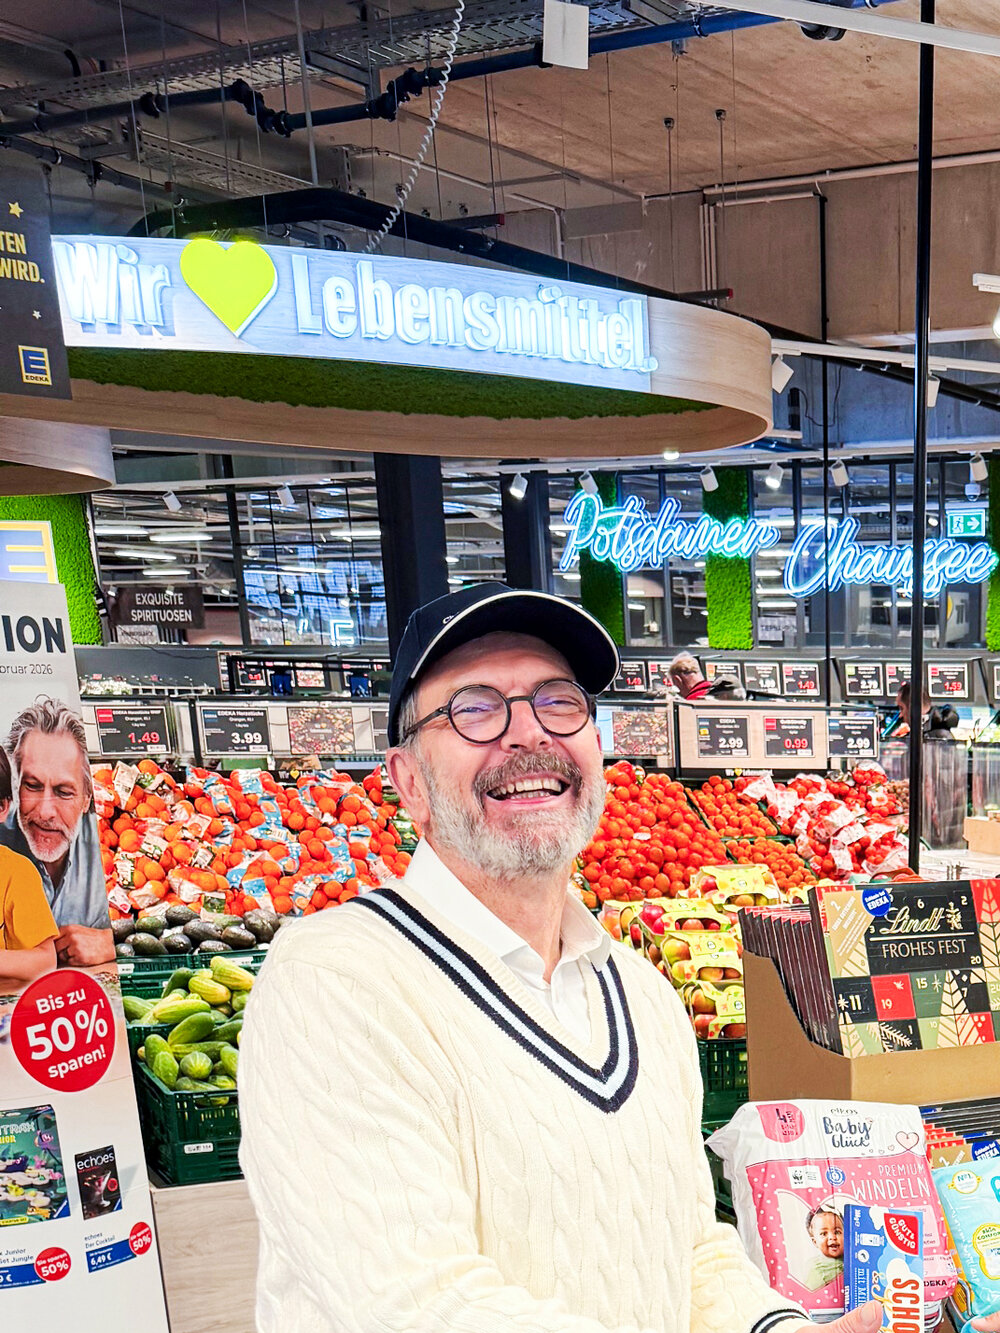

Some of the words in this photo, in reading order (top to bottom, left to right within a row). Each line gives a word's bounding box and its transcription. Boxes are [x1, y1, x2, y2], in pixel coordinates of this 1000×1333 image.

[0, 257, 45, 284] WIRD.
[55, 241, 173, 328] Wir
[559, 488, 780, 573] Potsdamer
[135, 592, 185, 606] EXQUISITE
[131, 609, 193, 623] SPIRITUOSEN
[30, 663, 53, 675] 2026
[128, 731, 160, 744] 1.49
[231, 731, 263, 744] 3.99
[718, 737, 744, 749] 2.99
[784, 738, 809, 749] 0.99
[847, 737, 871, 749] 2.99
[867, 896, 890, 911] EDEKA
[879, 905, 946, 935] Lindt
[882, 940, 936, 959] FROHES
[938, 938, 968, 955] FEST
[36, 996, 64, 1015] Bis
[67, 988, 86, 1003] zu
[881, 999, 893, 1010] 19
[48, 1044, 107, 1079] sparen!
[823, 1115, 873, 1141] Baby
[831, 1133, 871, 1149] Glück
[76, 1152, 115, 1171] echoes
[877, 1163, 926, 1178] PREMIUM
[851, 1177, 932, 1201] WINDELN
[888, 1216, 917, 1250] GÜNSTIG
